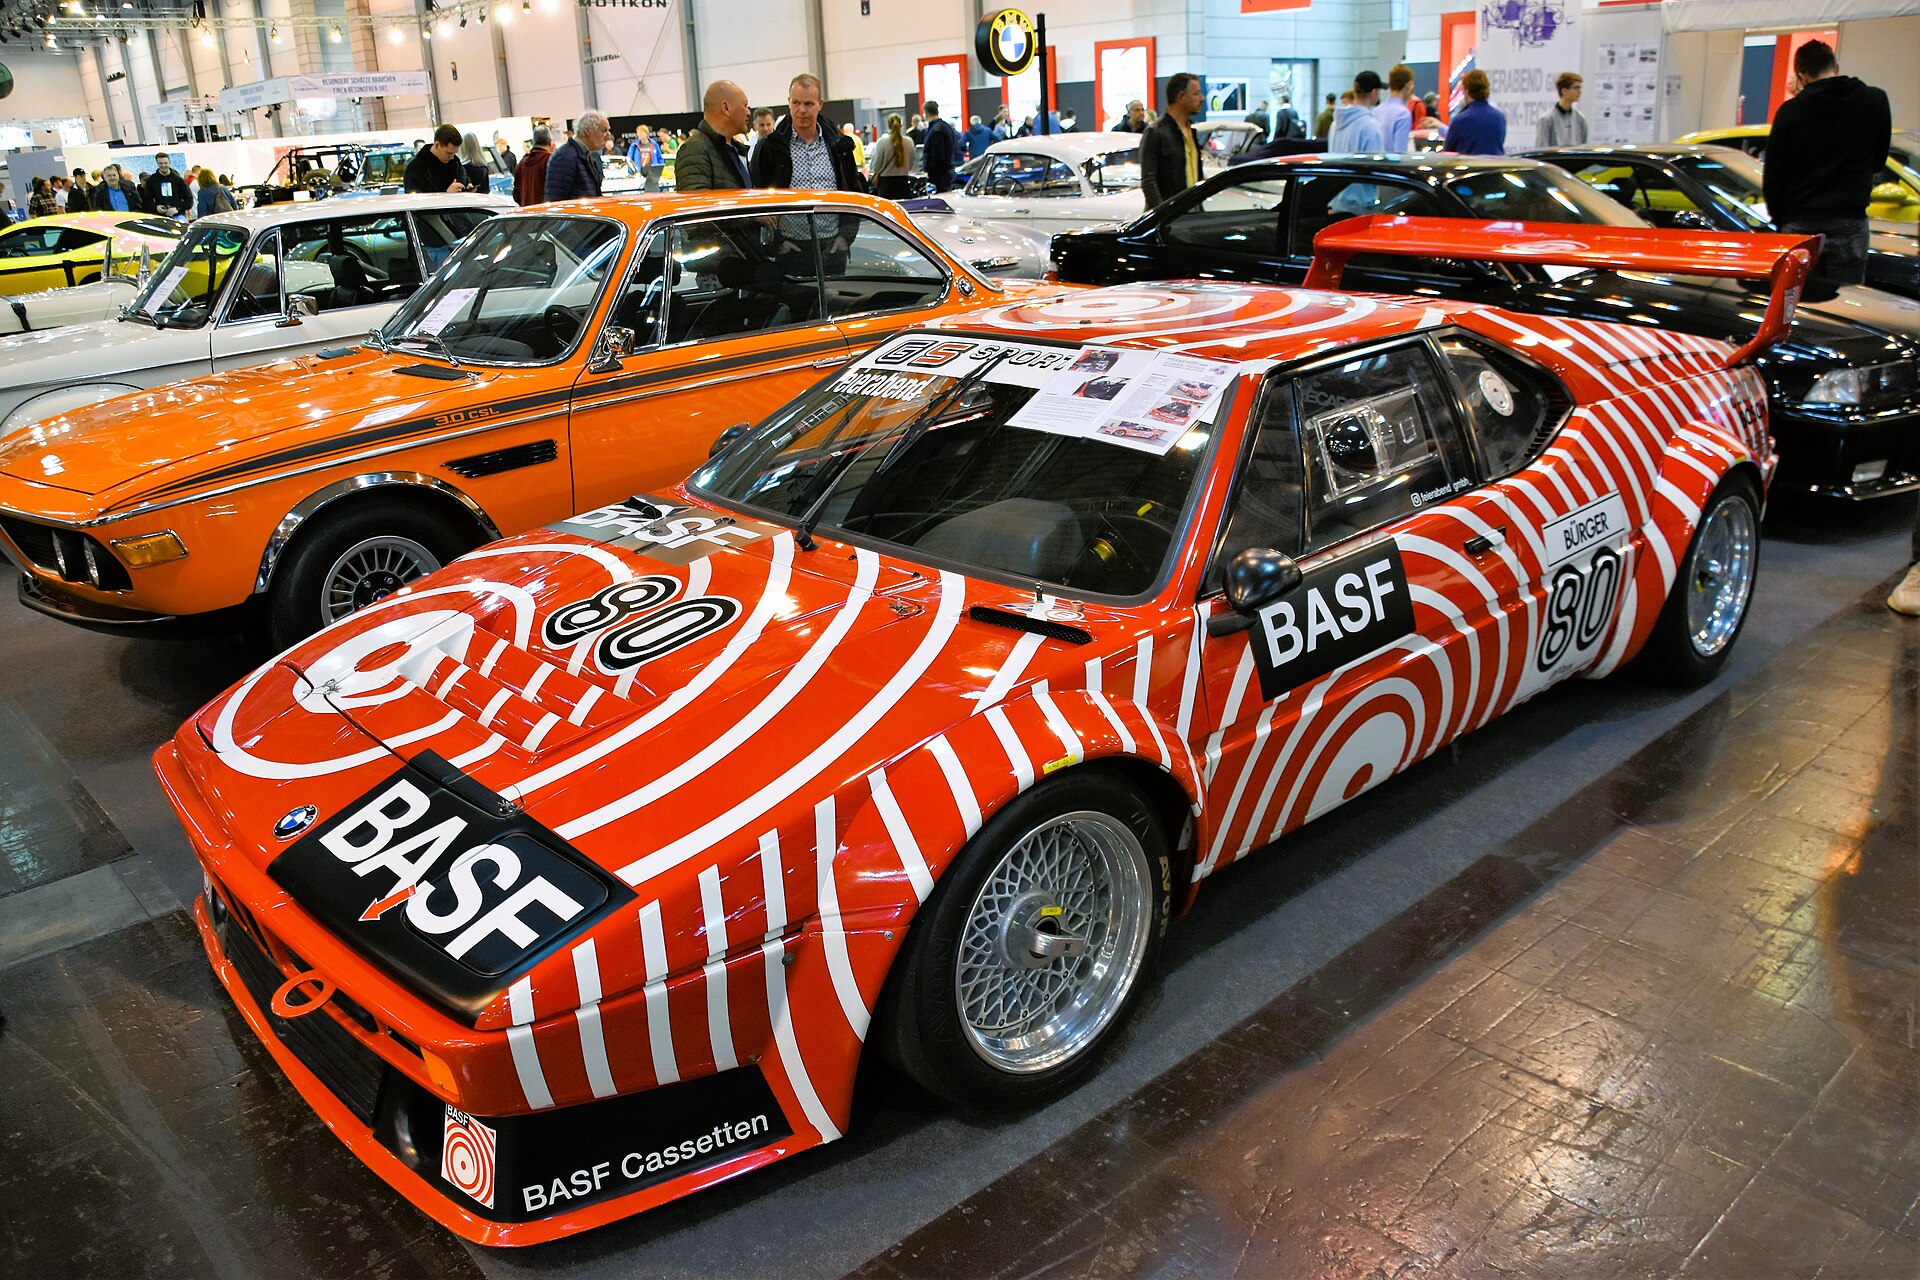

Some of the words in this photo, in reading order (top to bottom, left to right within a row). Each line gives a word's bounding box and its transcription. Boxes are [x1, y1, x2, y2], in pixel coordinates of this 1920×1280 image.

[993, 12, 1032, 34] BMW
[875, 339, 979, 367] GS
[434, 412, 465, 426] 3.0
[1420, 483, 1452, 502] feierabend
[562, 498, 763, 549] BASF
[1563, 511, 1610, 550] BÜRGER
[541, 573, 743, 677] 80
[1258, 558, 1395, 669] BASF
[1536, 545, 1620, 673] 80
[318, 778, 585, 961] BASF
[447, 1103, 469, 1126] BASF
[522, 1161, 610, 1212] BASF
[621, 1112, 770, 1179] Cassetten
